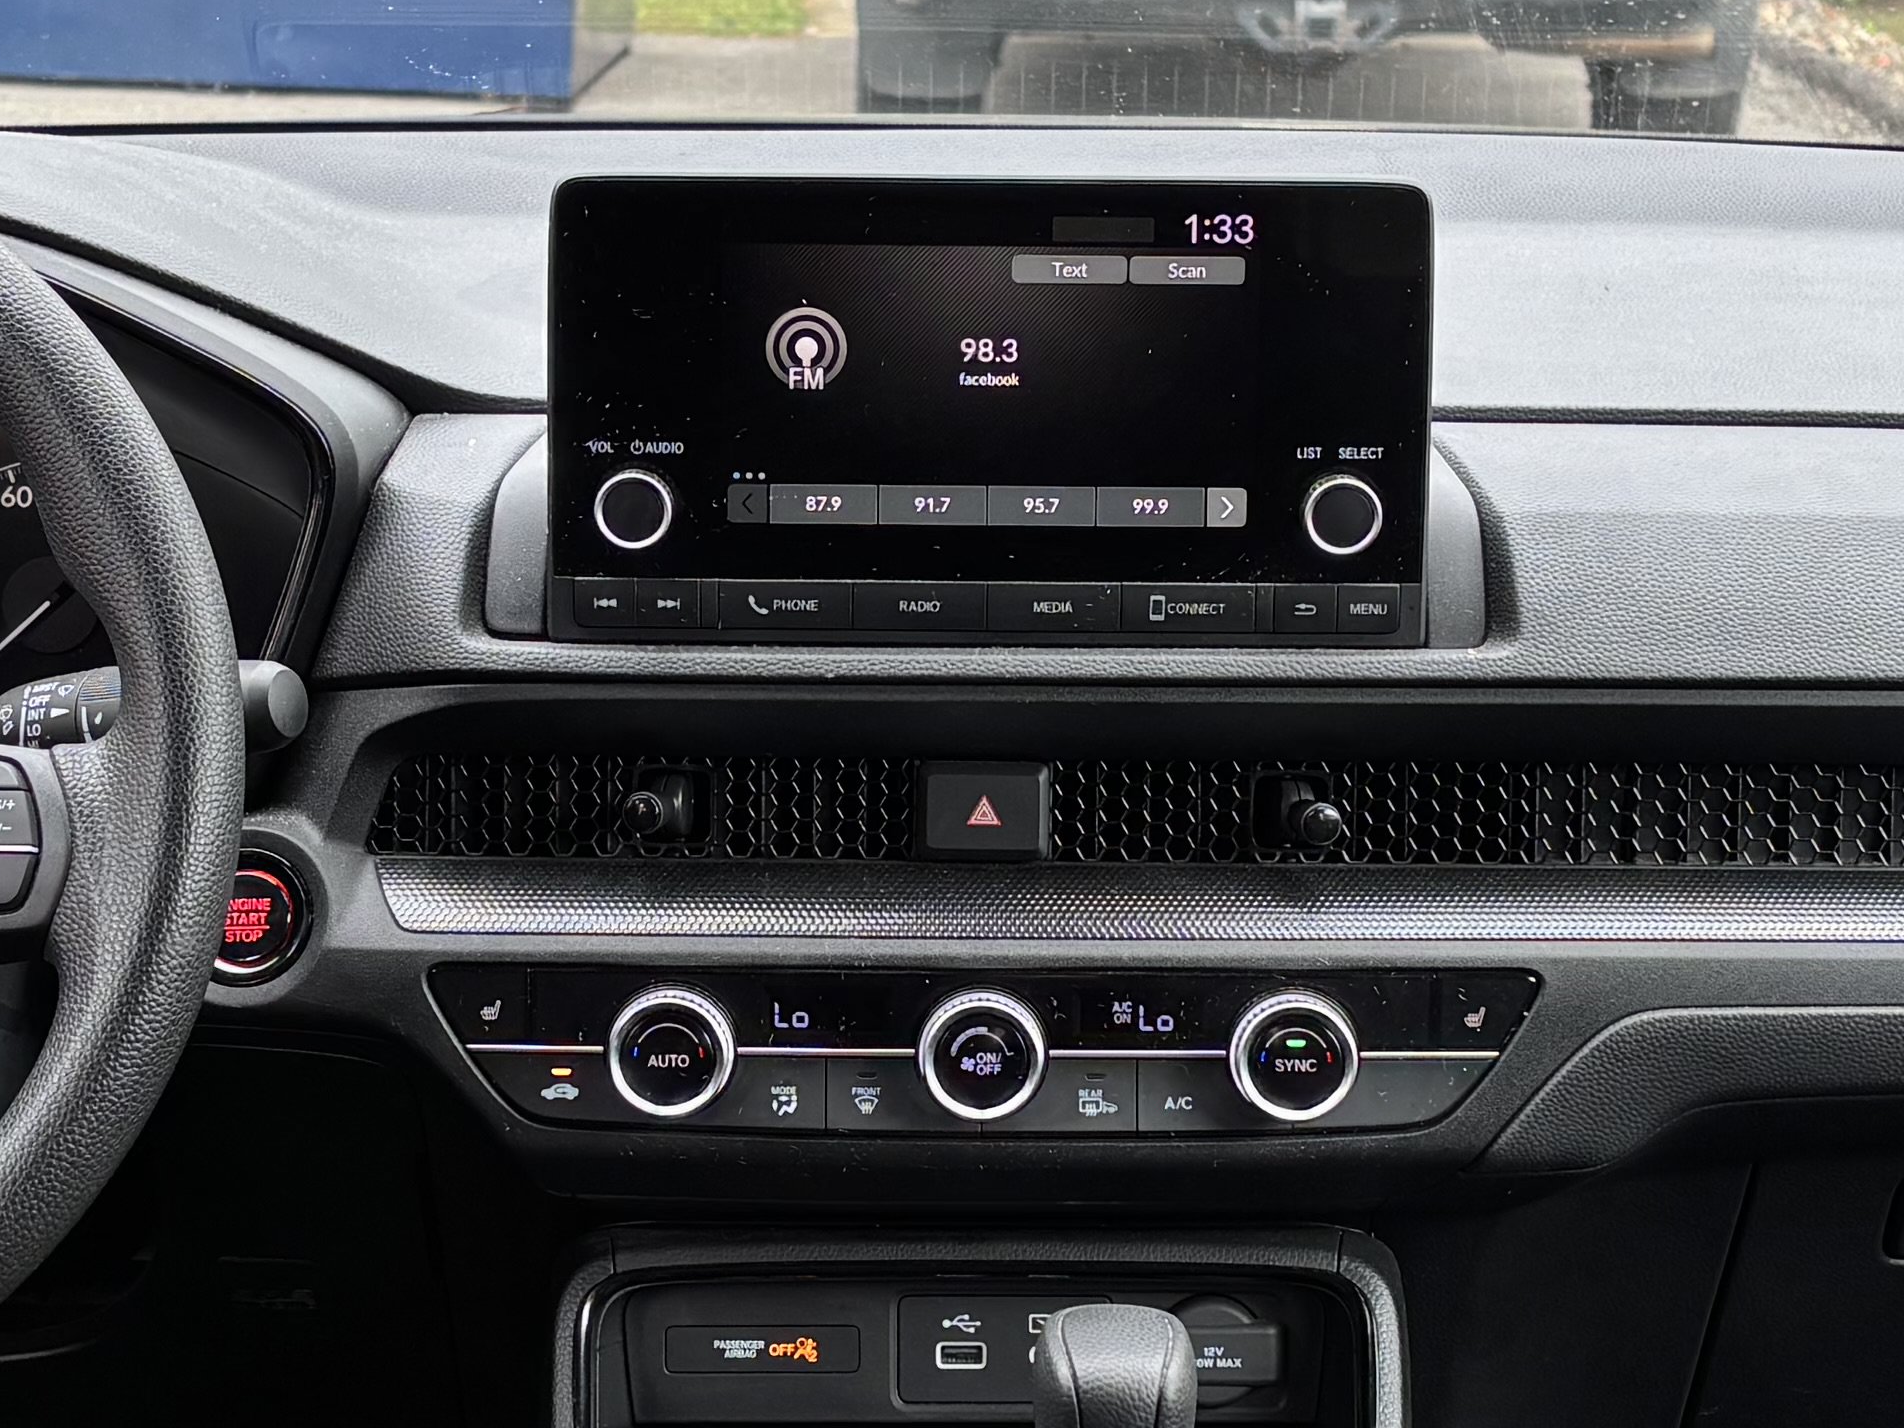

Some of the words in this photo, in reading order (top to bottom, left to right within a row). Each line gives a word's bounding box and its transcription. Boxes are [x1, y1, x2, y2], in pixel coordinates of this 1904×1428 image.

[1182, 215, 1256, 246] 1:33
[1051, 261, 1089, 280] Text
[1166, 261, 1207, 280] Scan
[959, 338, 1020, 364] 98.3
[787, 368, 826, 391] FM
[958, 372, 1020, 388] facebook
[589, 441, 615, 455] VOL
[644, 440, 686, 456] AUDIO
[1296, 446, 1324, 460] LIST
[1337, 446, 1385, 461] SELECT
[0, 485, 33, 510] 60
[804, 496, 843, 514] 87.9
[913, 497, 953, 515] 91.7
[1022, 498, 1061, 516] 95.7
[1130, 499, 1171, 517] 99.9
[772, 598, 820, 615] PHONE
[898, 599, 942, 615] RADIO
[1032, 600, 1075, 616] MEDIA
[1166, 600, 1227, 617] CONNECT
[1348, 600, 1389, 617] MENU
[28, 694, 51, 708] OFF
[27, 707, 46, 721] INT
[26, 723, 41, 737] LO
[227, 898, 271, 911] NGINE
[225, 912, 268, 925] START
[224, 930, 264, 943] STOP
[1112, 1000, 1133, 1012] A/C
[1114, 1012, 1131, 1024] ON
[647, 1053, 691, 1069] AUTO
[976, 1051, 1002, 1064] ON/
[976, 1063, 1003, 1076] OFF
[1274, 1058, 1318, 1074] SYNC
[770, 1086, 797, 1096] MODE
[851, 1086, 882, 1097] FRONT
[1077, 1088, 1104, 1098] REAR
[1164, 1095, 1194, 1111] A/C
[713, 1340, 765, 1350] PASSENGER
[768, 1343, 796, 1357] OFF
[1203, 1346, 1224, 1357] 12V
[1216, 1357, 1242, 1368] MAX
